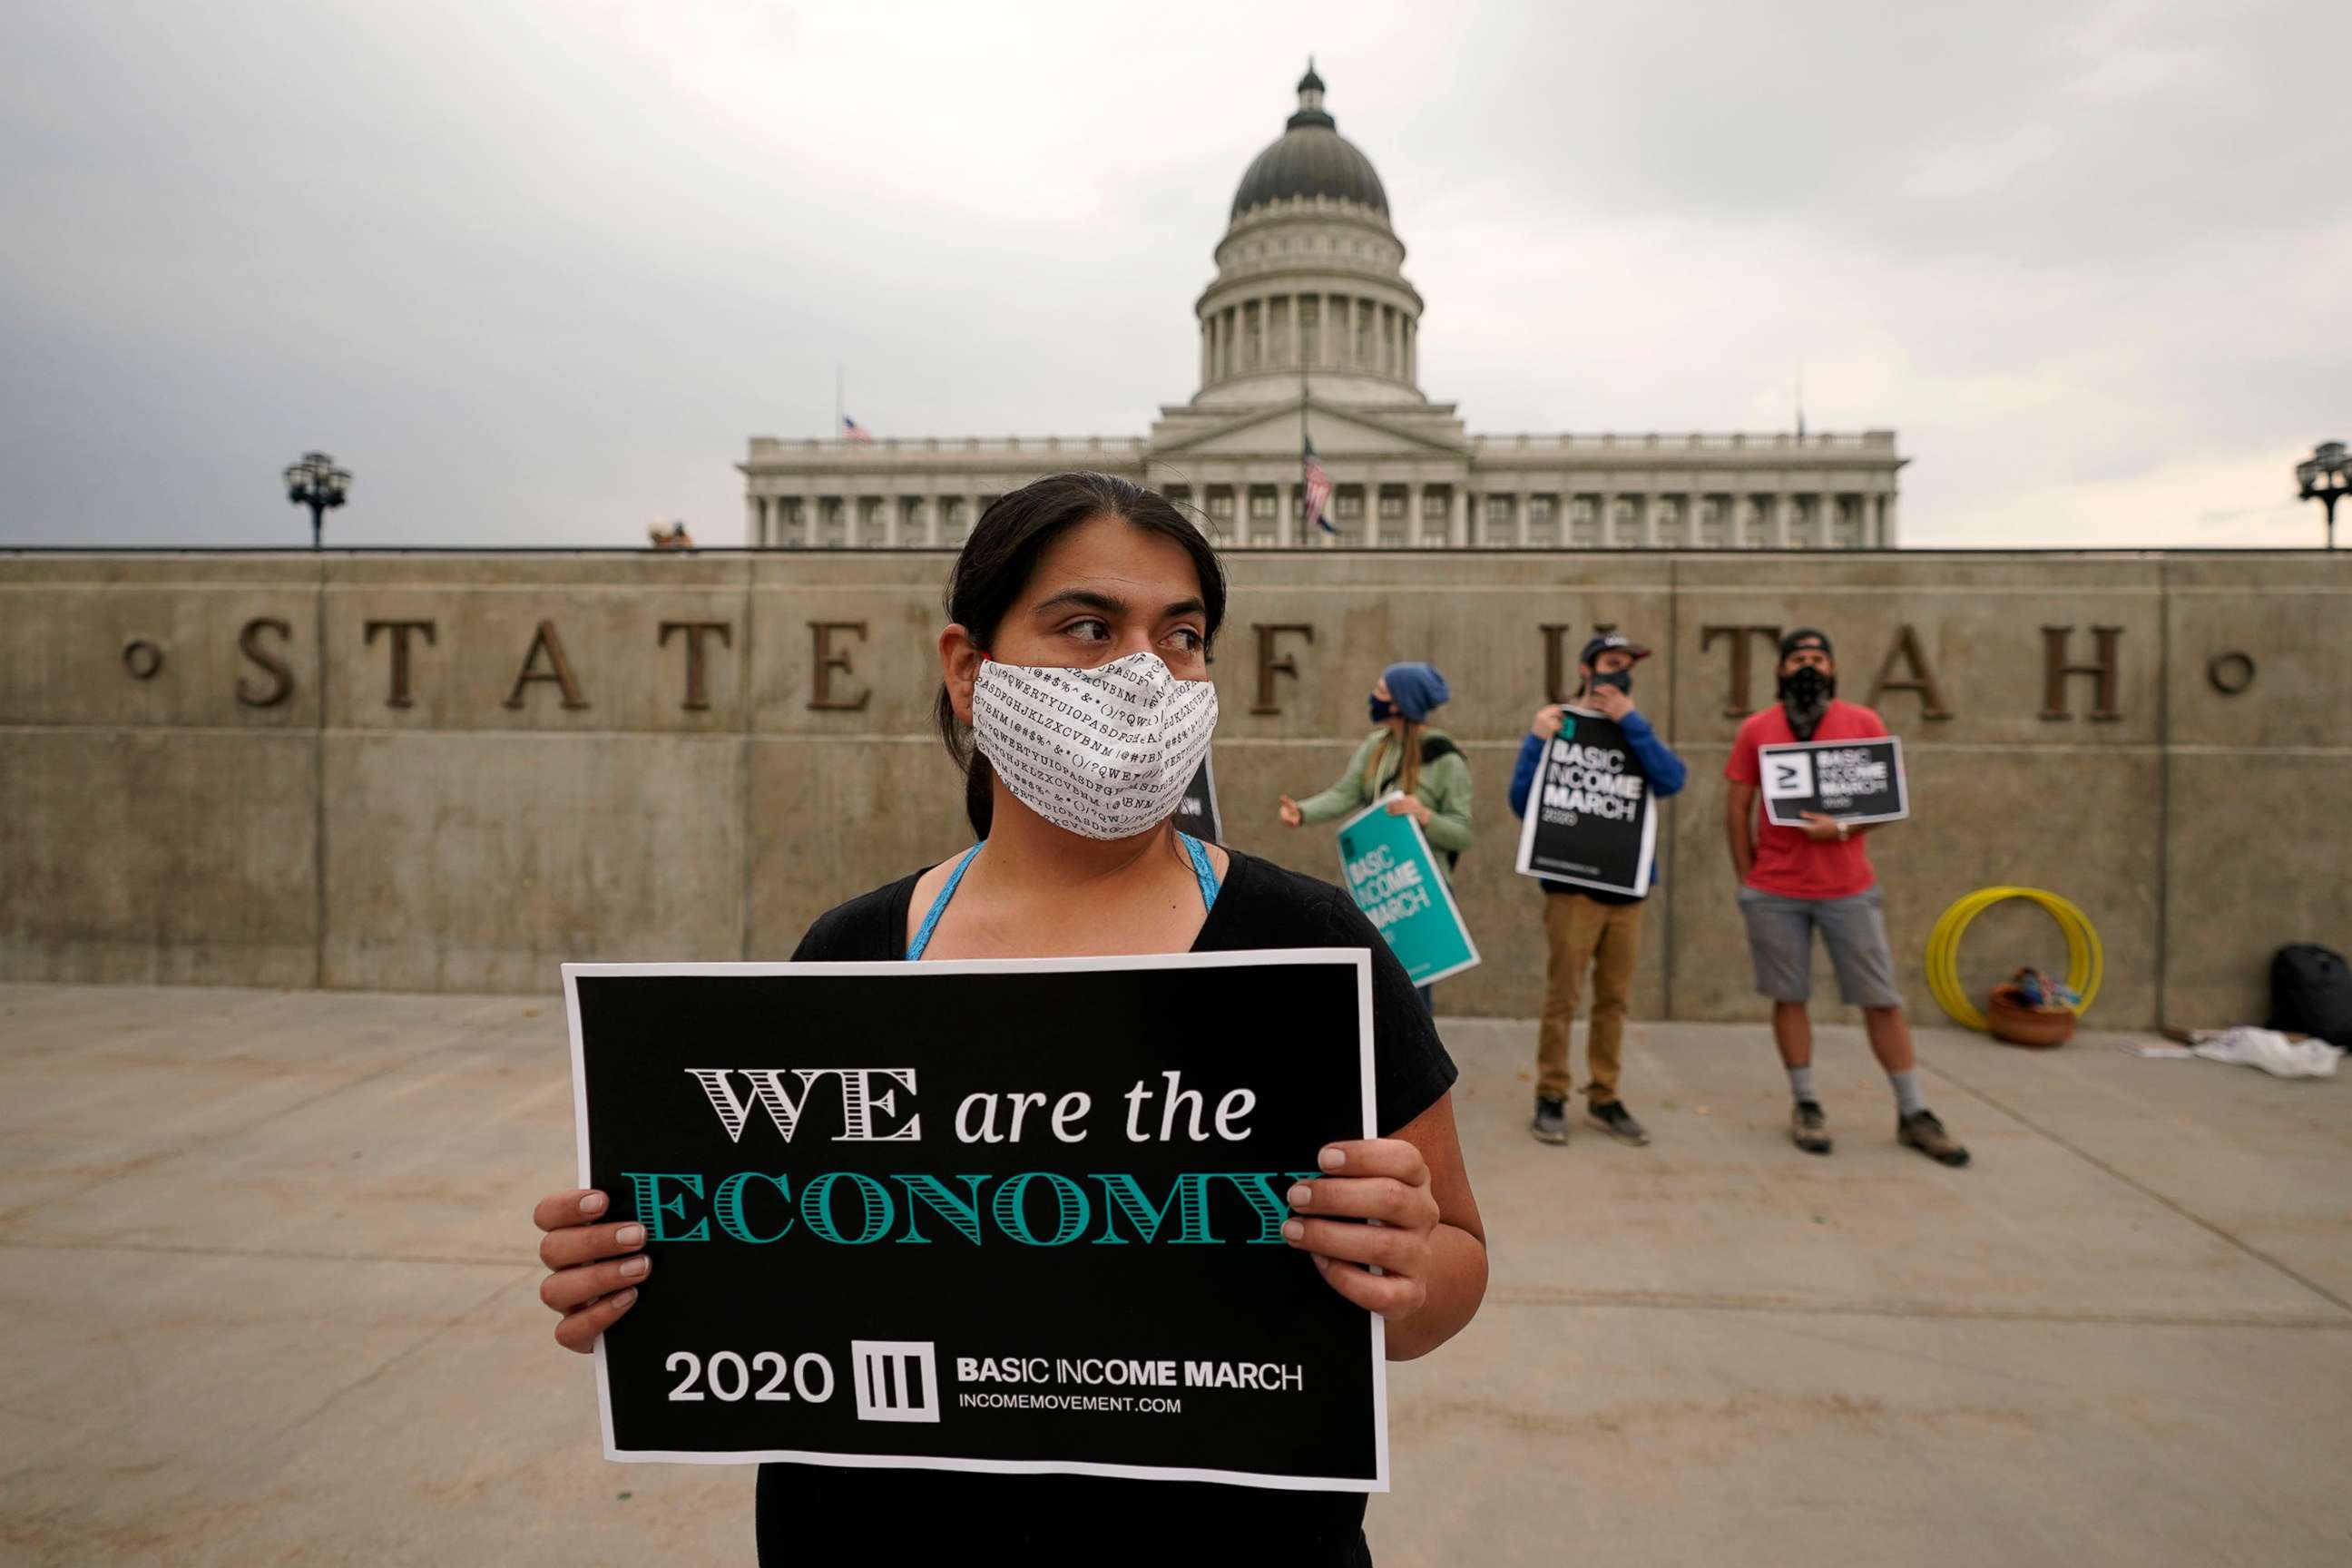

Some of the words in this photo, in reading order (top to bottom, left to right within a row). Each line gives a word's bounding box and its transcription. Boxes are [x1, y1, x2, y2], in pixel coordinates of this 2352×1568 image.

[236, 616, 870, 711] STATE
[1249, 622, 1314, 715] F
[1551, 739, 1625, 773] BASIC
[1544, 786, 1636, 822] MARCH
[684, 1067, 922, 1143] WE
[955, 1090, 1092, 1143] are
[1124, 1070, 1257, 1142] the
[620, 1171, 1325, 1246] ECONOMY
[665, 1350, 835, 1404] 2020
[957, 1357, 1050, 1383] BASIC
[1056, 1358, 1178, 1387] INCOME
[1183, 1360, 1303, 1391] MARCH
[959, 1393, 1181, 1414] INCOMEMOVEMENT.COM
